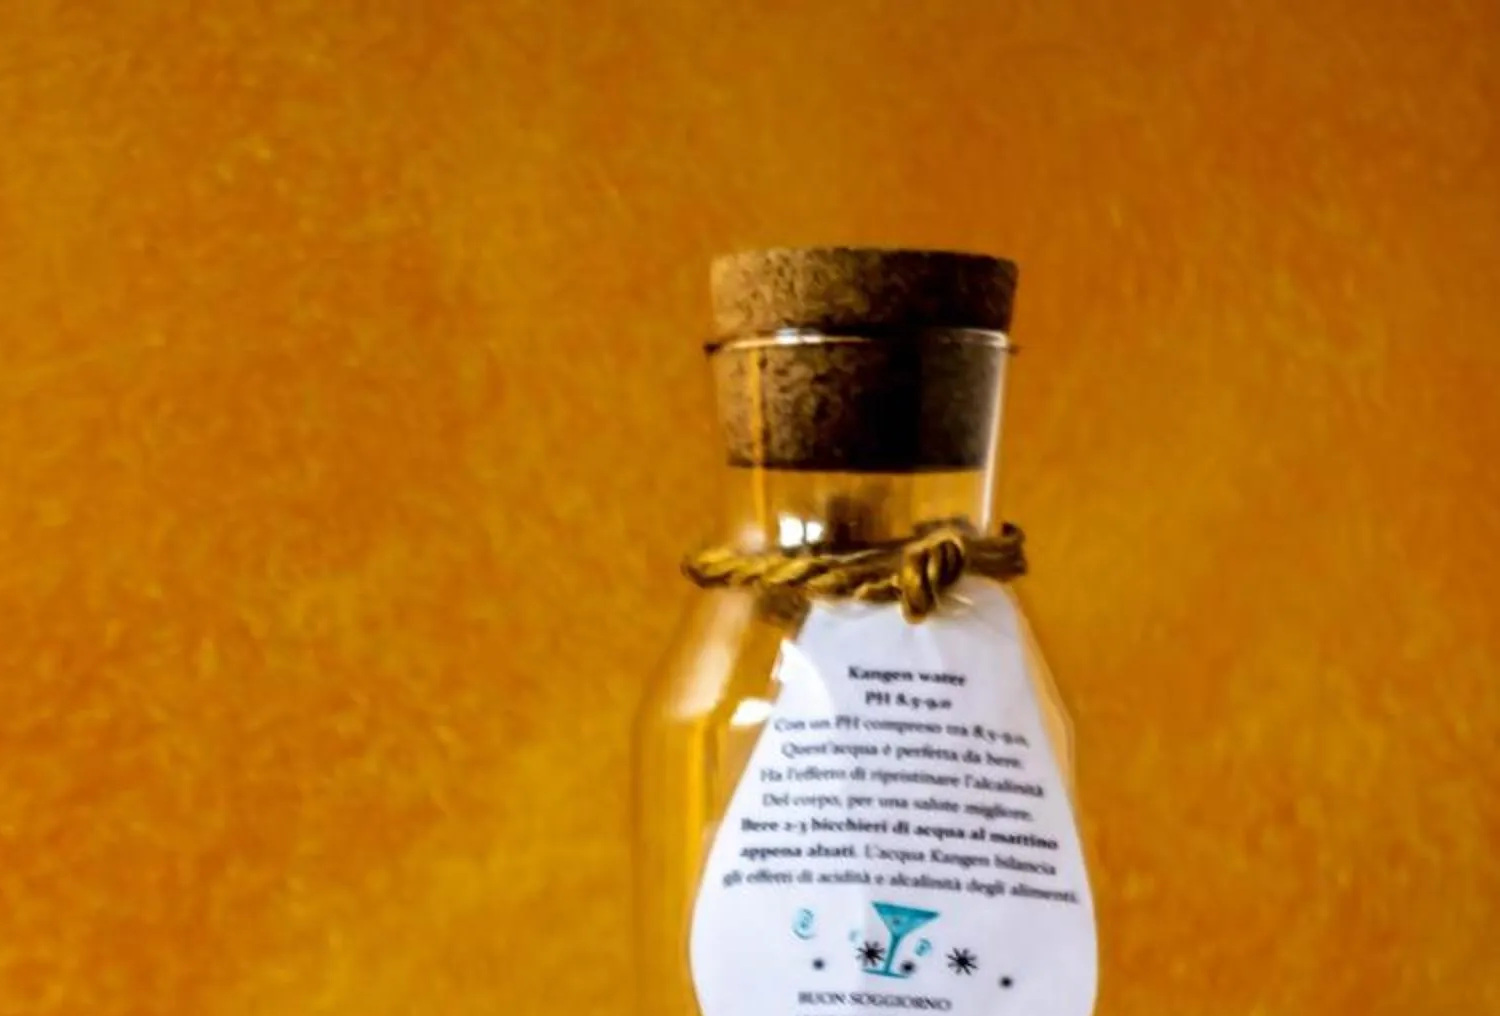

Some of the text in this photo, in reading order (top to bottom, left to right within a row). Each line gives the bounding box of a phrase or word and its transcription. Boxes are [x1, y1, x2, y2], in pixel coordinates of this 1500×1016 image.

[847, 665, 966, 687] Kangen water
[864, 690, 890, 705] PH
[773, 717, 805, 731] Con
[809, 719, 830, 730] un
[835, 714, 861, 730] PH
[862, 719, 942, 735] compreso
[961, 749, 982, 764] da
[760, 768, 783, 782] Ha
[850, 766, 866, 781] di
[762, 793, 789, 807] Del
[847, 796, 873, 810] per
[877, 797, 909, 809] una
[912, 798, 959, 813] salute
[741, 818, 779, 832] Bere
[811, 817, 888, 834] bicchieri
[892, 820, 910, 834] di
[913, 826, 966, 841] acqua
[970, 826, 986, 841] al
[989, 831, 1059, 850] mattino
[740, 846, 802, 861] appena
[930, 849, 991, 869] Kangen
[722, 870, 743, 887] gli
[797, 869, 814, 883] di
[875, 874, 885, 885] e
[966, 878, 1006, 898] degli
[797, 991, 953, 1011] BUON SOGGIORNO
